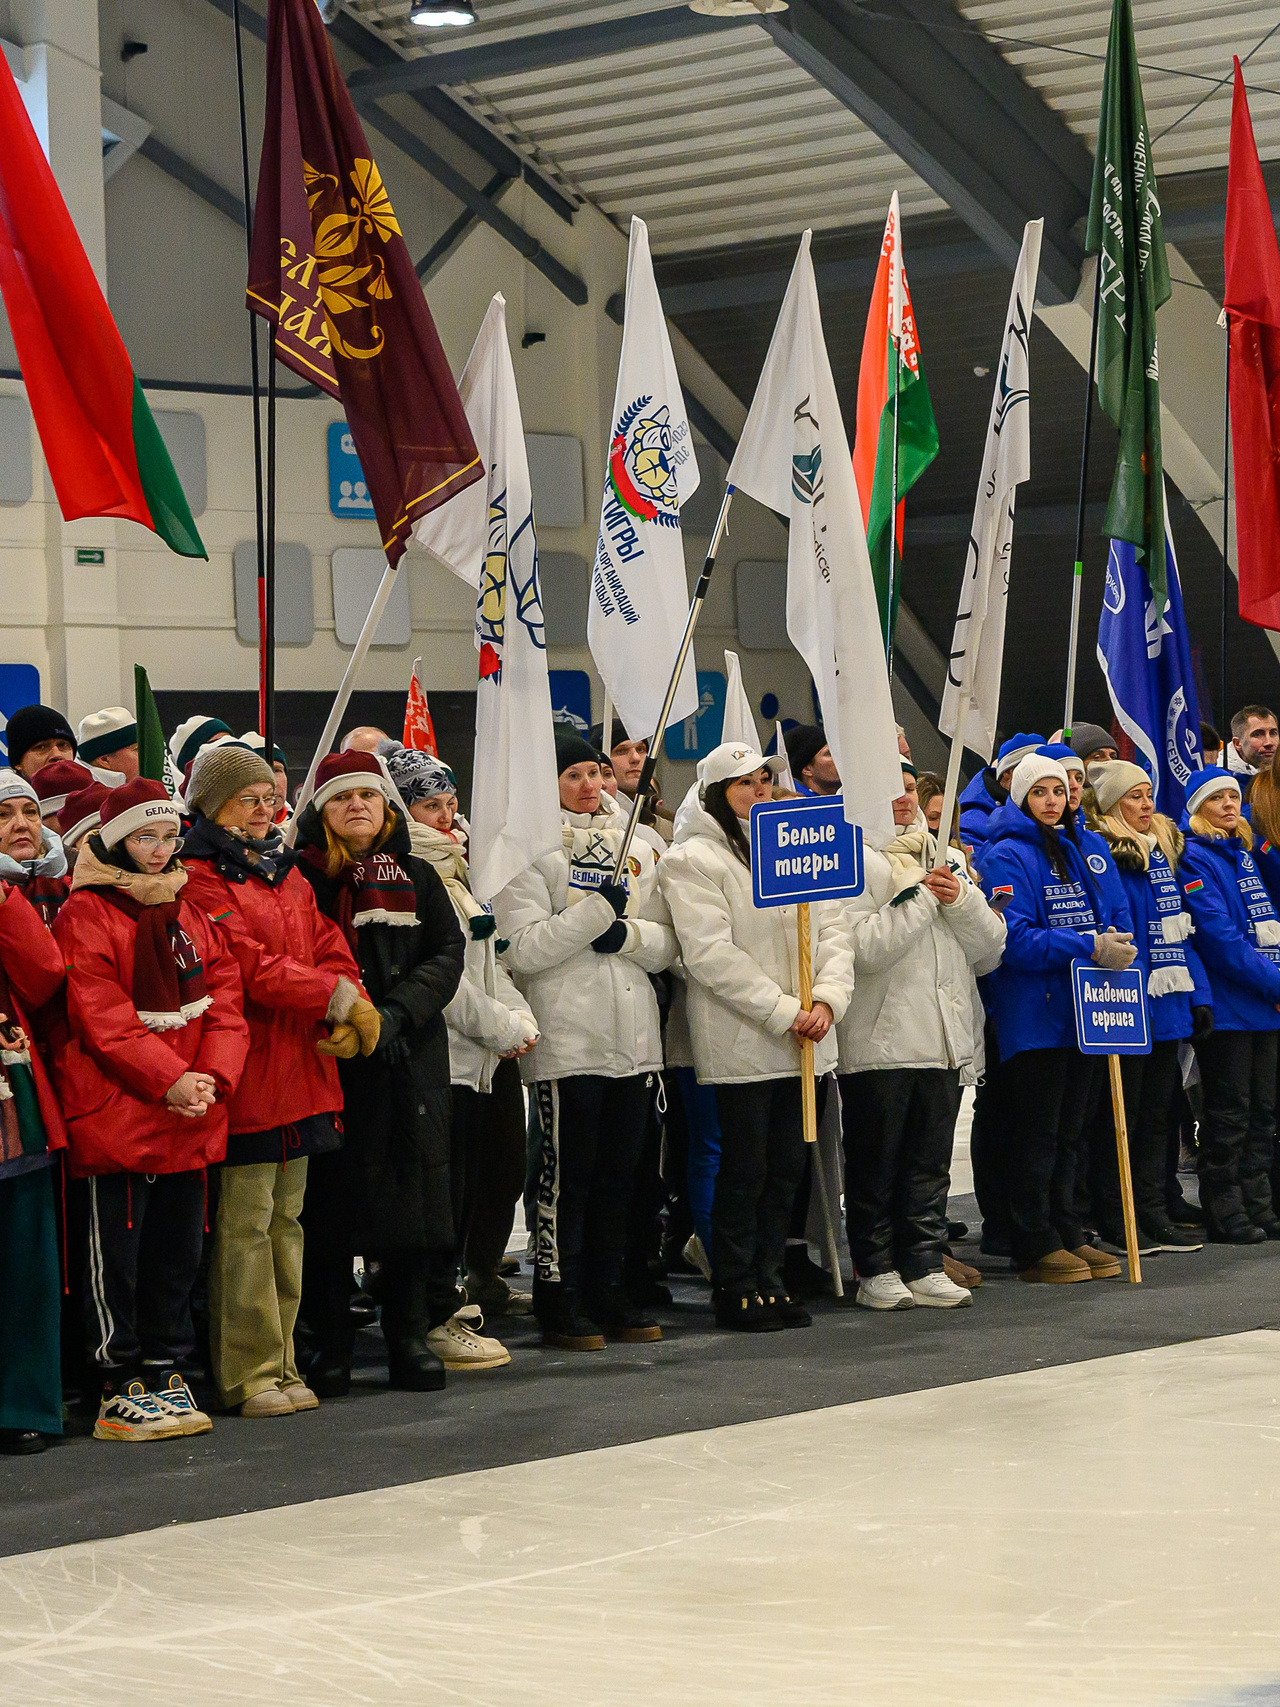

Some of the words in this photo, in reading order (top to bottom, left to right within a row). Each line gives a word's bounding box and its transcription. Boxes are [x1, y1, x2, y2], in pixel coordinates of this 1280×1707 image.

[603, 492, 645, 564] ТИГРЫ
[600, 552, 641, 626] ОРГАНИЗАЦИЙ
[777, 821, 837, 848] Белые
[775, 852, 840, 880] тигры
[1083, 981, 1139, 1004] Академия
[1091, 1010, 1135, 1033] сервиса
